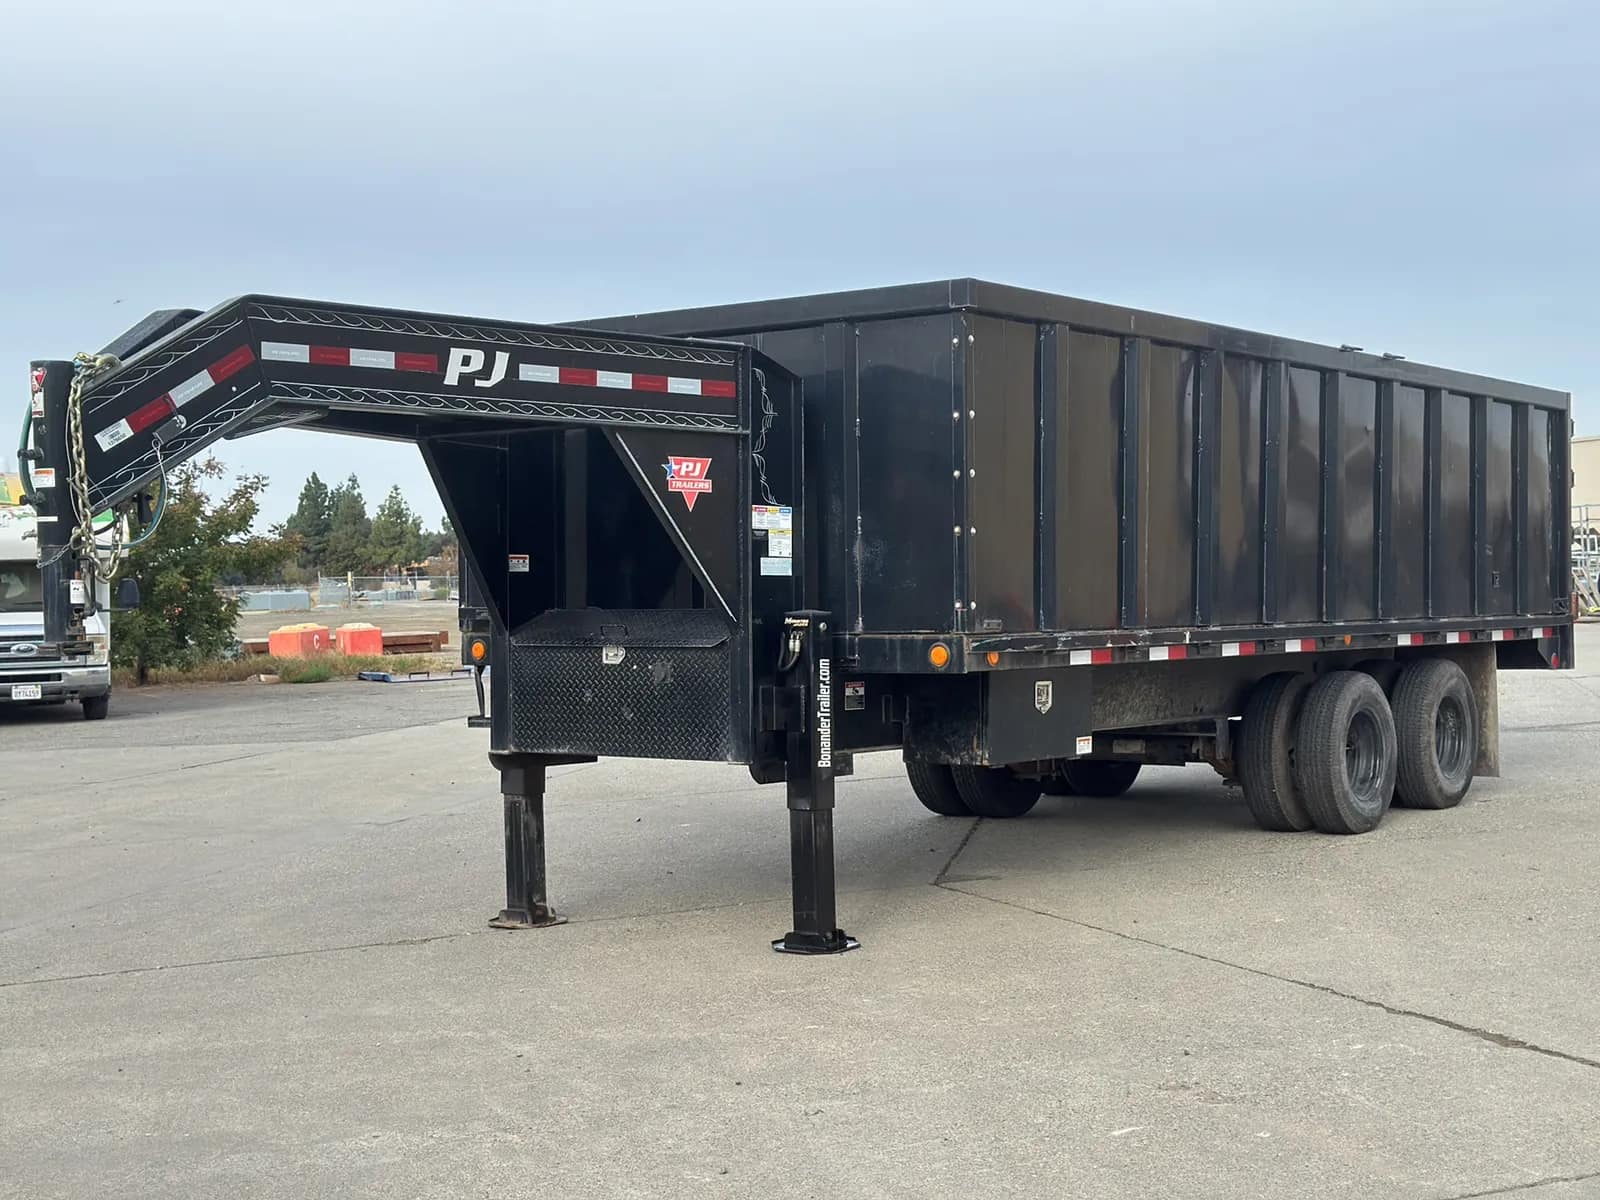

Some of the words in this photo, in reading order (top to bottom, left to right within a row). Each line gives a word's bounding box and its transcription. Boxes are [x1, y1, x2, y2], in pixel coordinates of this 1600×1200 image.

[443, 347, 510, 388] PJ
[680, 461, 702, 477] PJ
[671, 480, 710, 490] TRAILERS
[817, 658, 831, 768] BonanderTrailer.com
